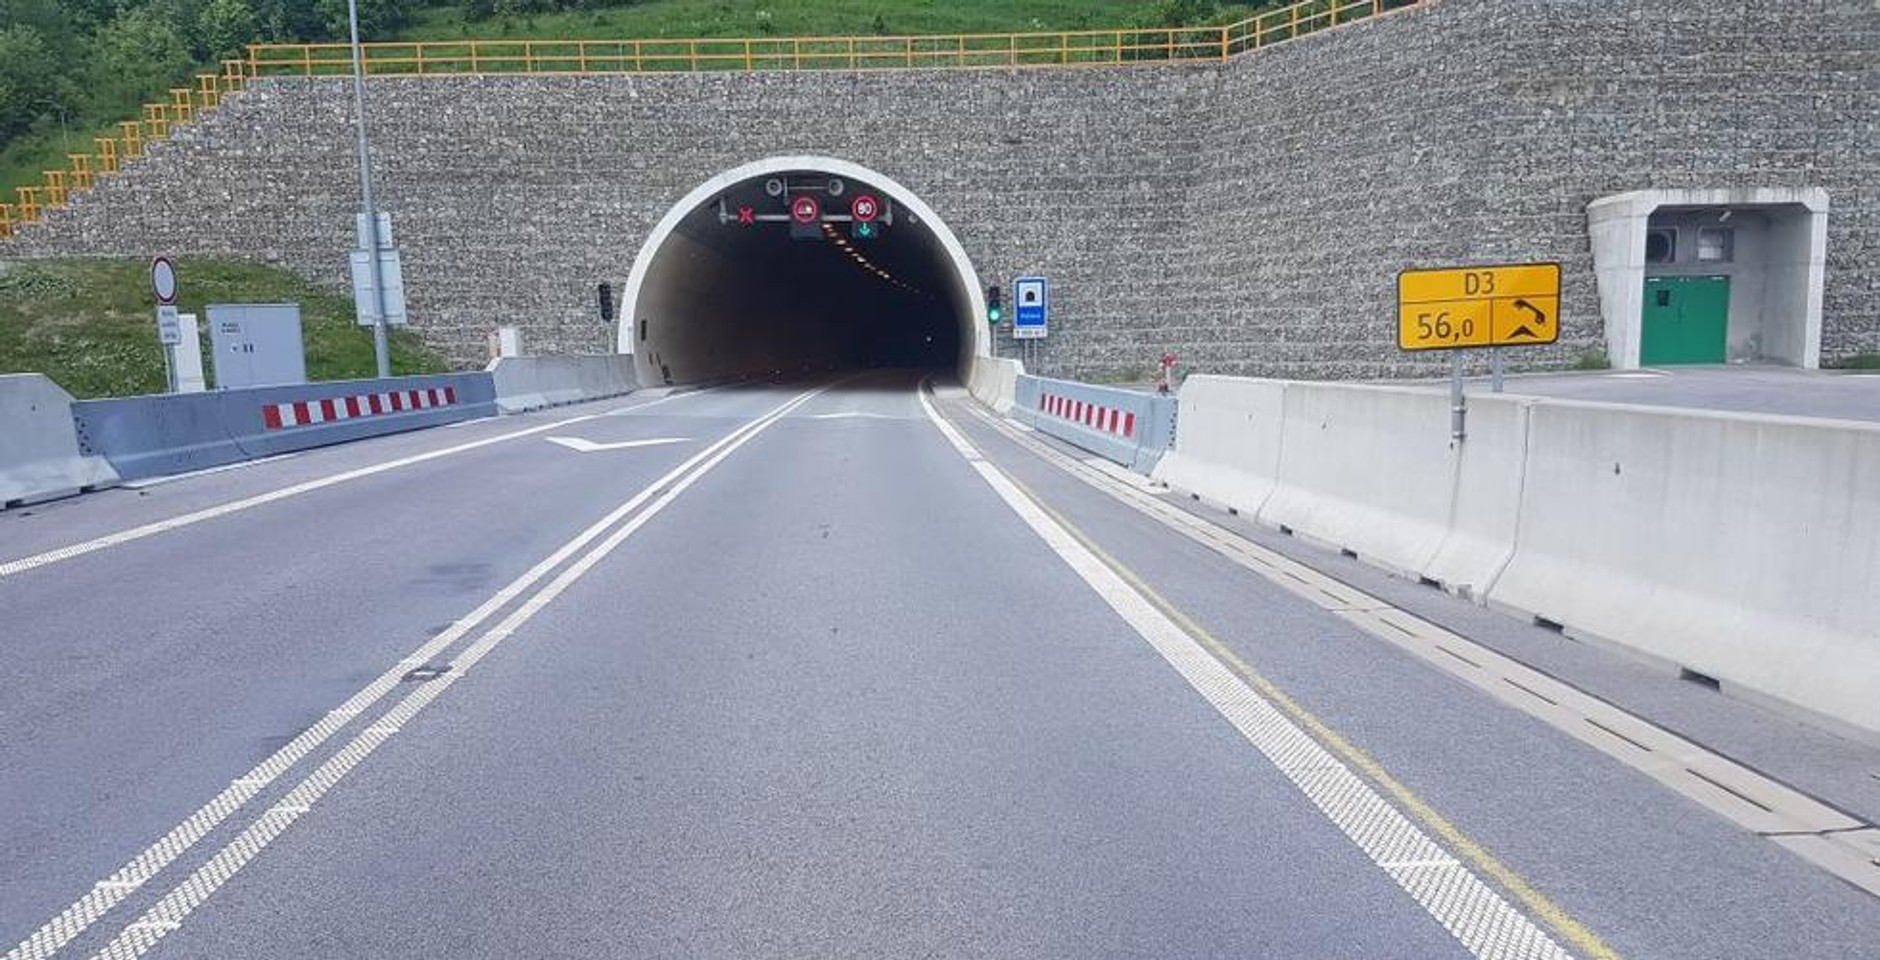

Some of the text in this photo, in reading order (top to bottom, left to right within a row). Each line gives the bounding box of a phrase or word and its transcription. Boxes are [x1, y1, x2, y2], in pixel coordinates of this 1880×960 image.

[857, 202, 873, 215] 80
[1464, 271, 1495, 295] D3
[1417, 311, 1475, 342] 56,0
